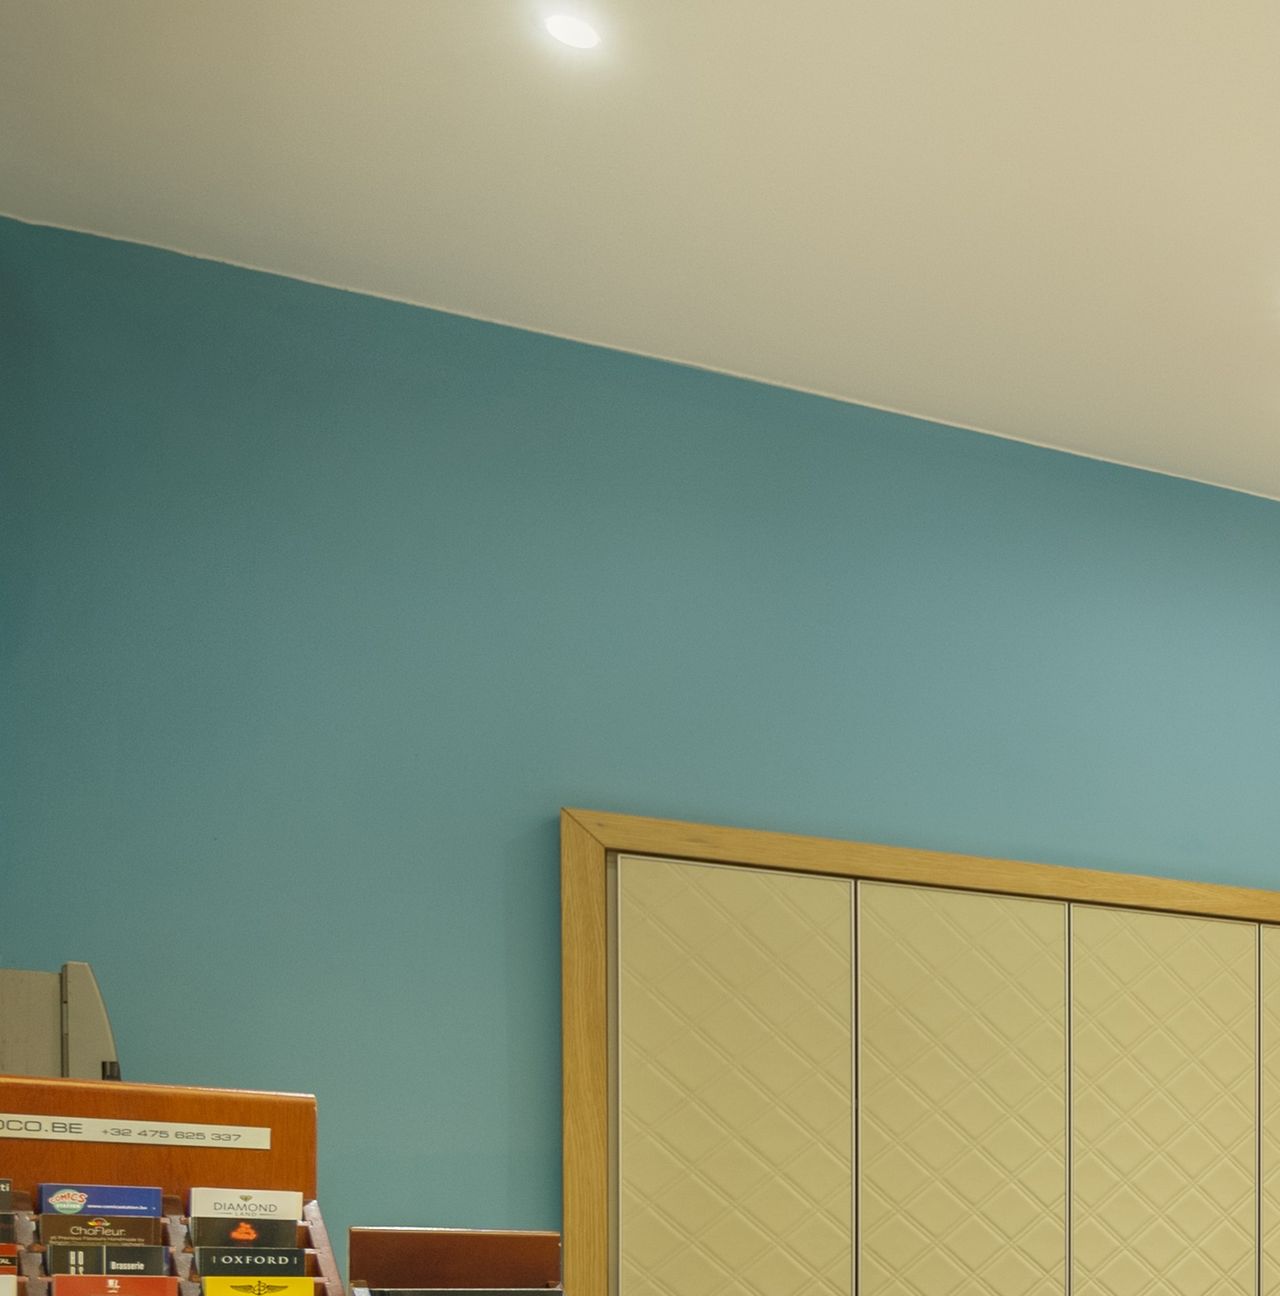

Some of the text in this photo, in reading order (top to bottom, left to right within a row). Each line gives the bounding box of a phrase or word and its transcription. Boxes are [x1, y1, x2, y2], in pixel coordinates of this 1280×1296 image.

[102, 1128, 132, 1137] +32
[137, 1129, 169, 1138] 475
[175, 1131, 206, 1140] 625
[211, 1132, 242, 1142] 337
[213, 1201, 278, 1213] DIAMOND
[221, 1255, 289, 1265] OXFORD
[111, 1261, 145, 1271] Brasserie
